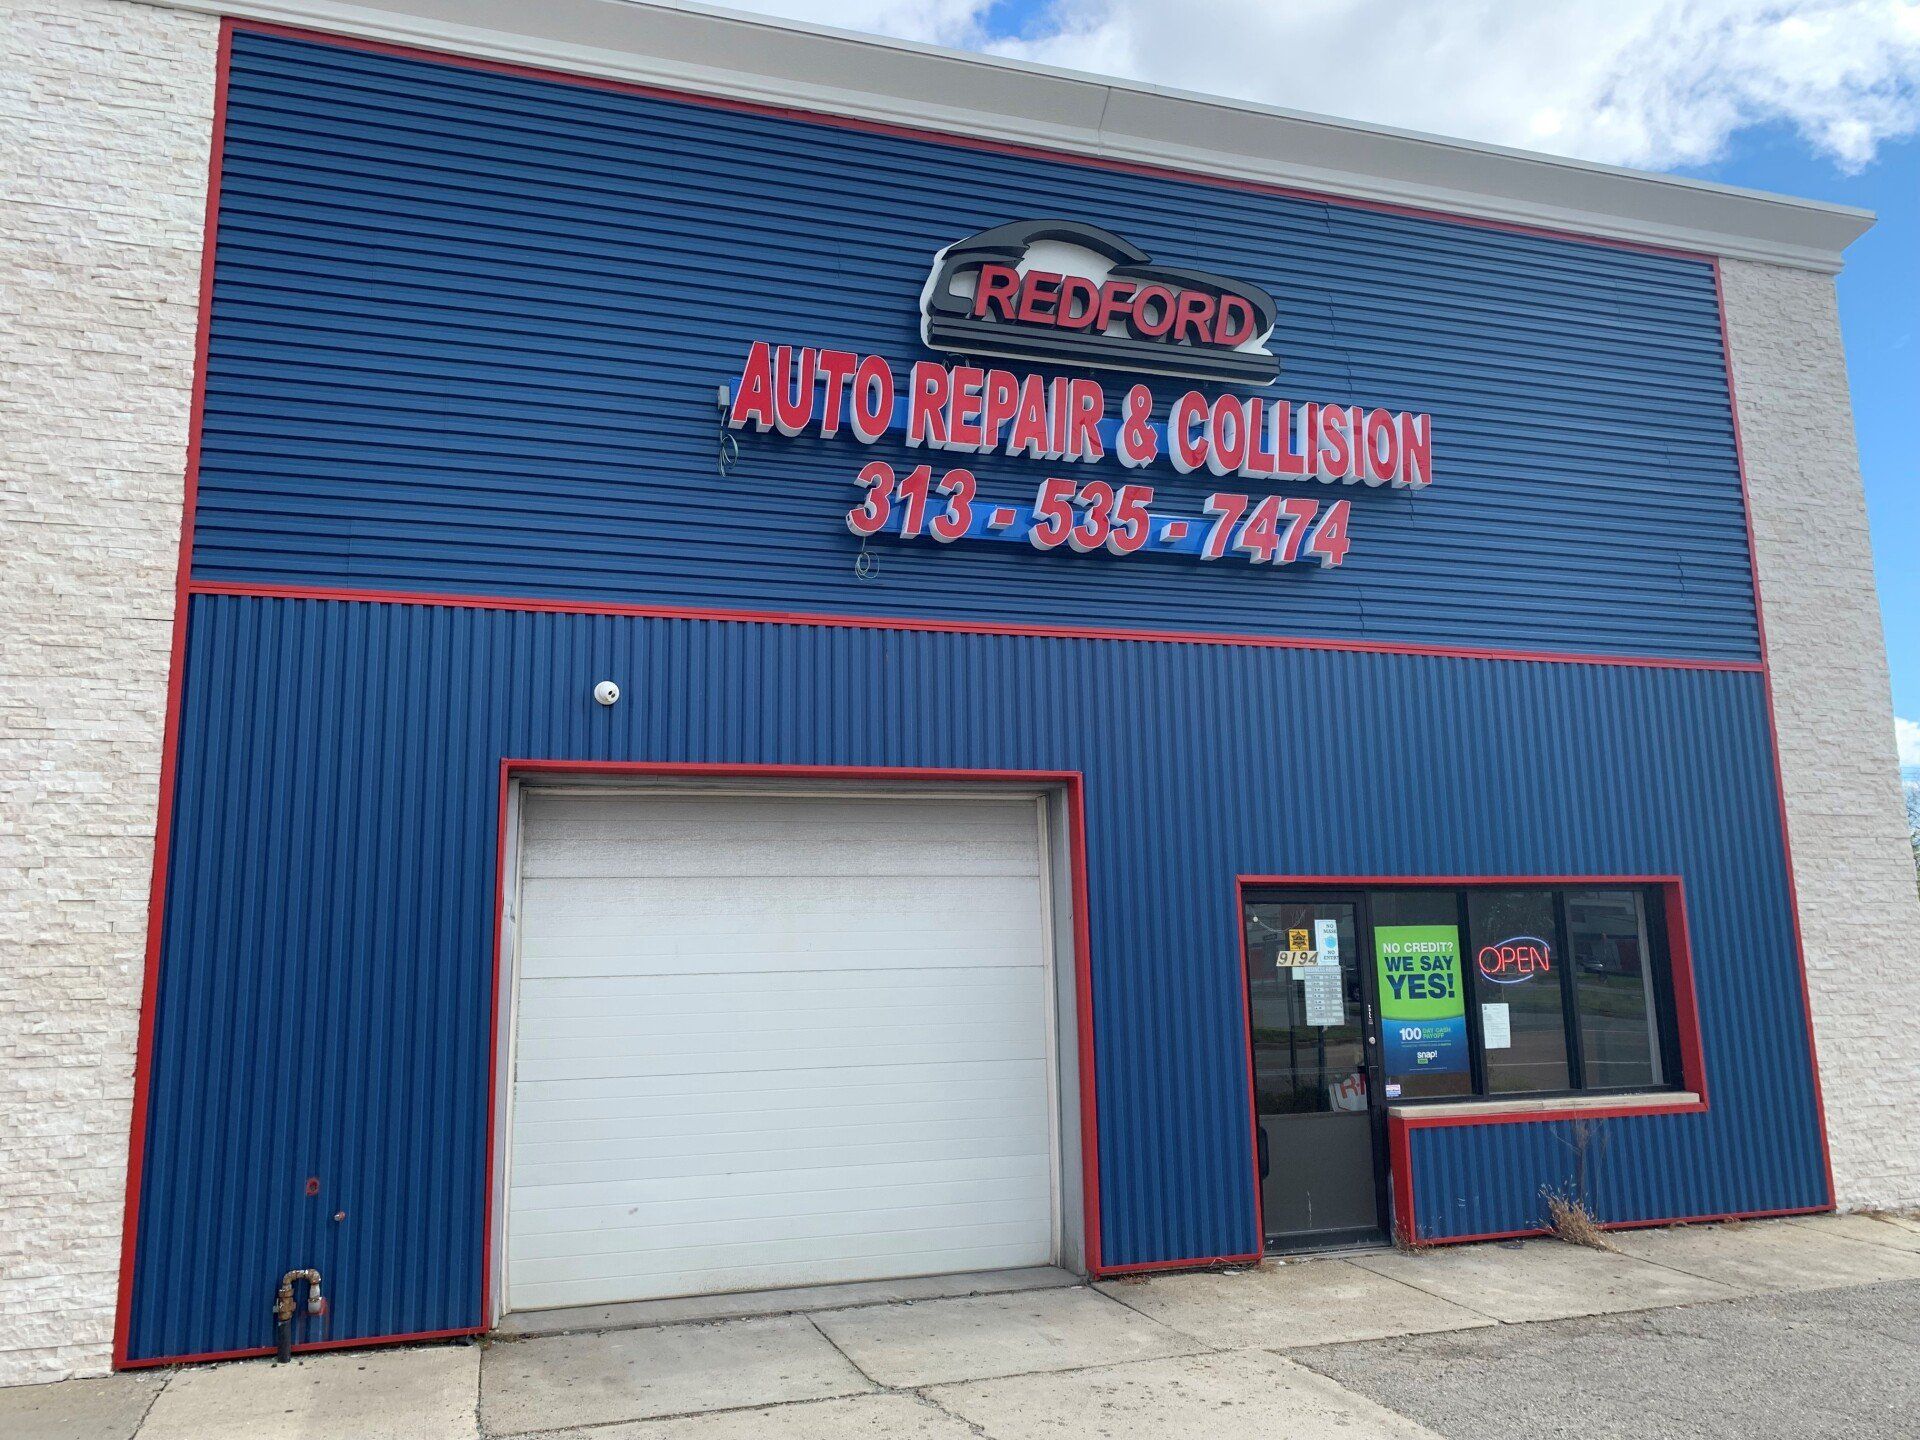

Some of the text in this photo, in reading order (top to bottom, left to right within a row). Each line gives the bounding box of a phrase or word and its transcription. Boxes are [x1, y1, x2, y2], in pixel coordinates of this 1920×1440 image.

[974, 263, 1256, 347] REDFORD
[729, 340, 1433, 489] AUTO REPAIR & COLLISION
[846, 461, 977, 543] 313
[1028, 478, 1154, 556] 535
[1200, 493, 1350, 568] 7474
[1278, 951, 1318, 965] 9194
[1382, 941, 1454, 954] NO CREDIT?
[1384, 955, 1454, 972] WE SAY
[1479, 946, 1550, 974] OPEN
[1385, 973, 1455, 1000] YES!
[1399, 1027, 1422, 1041] 100
[1416, 1050, 1438, 1060] snap!
